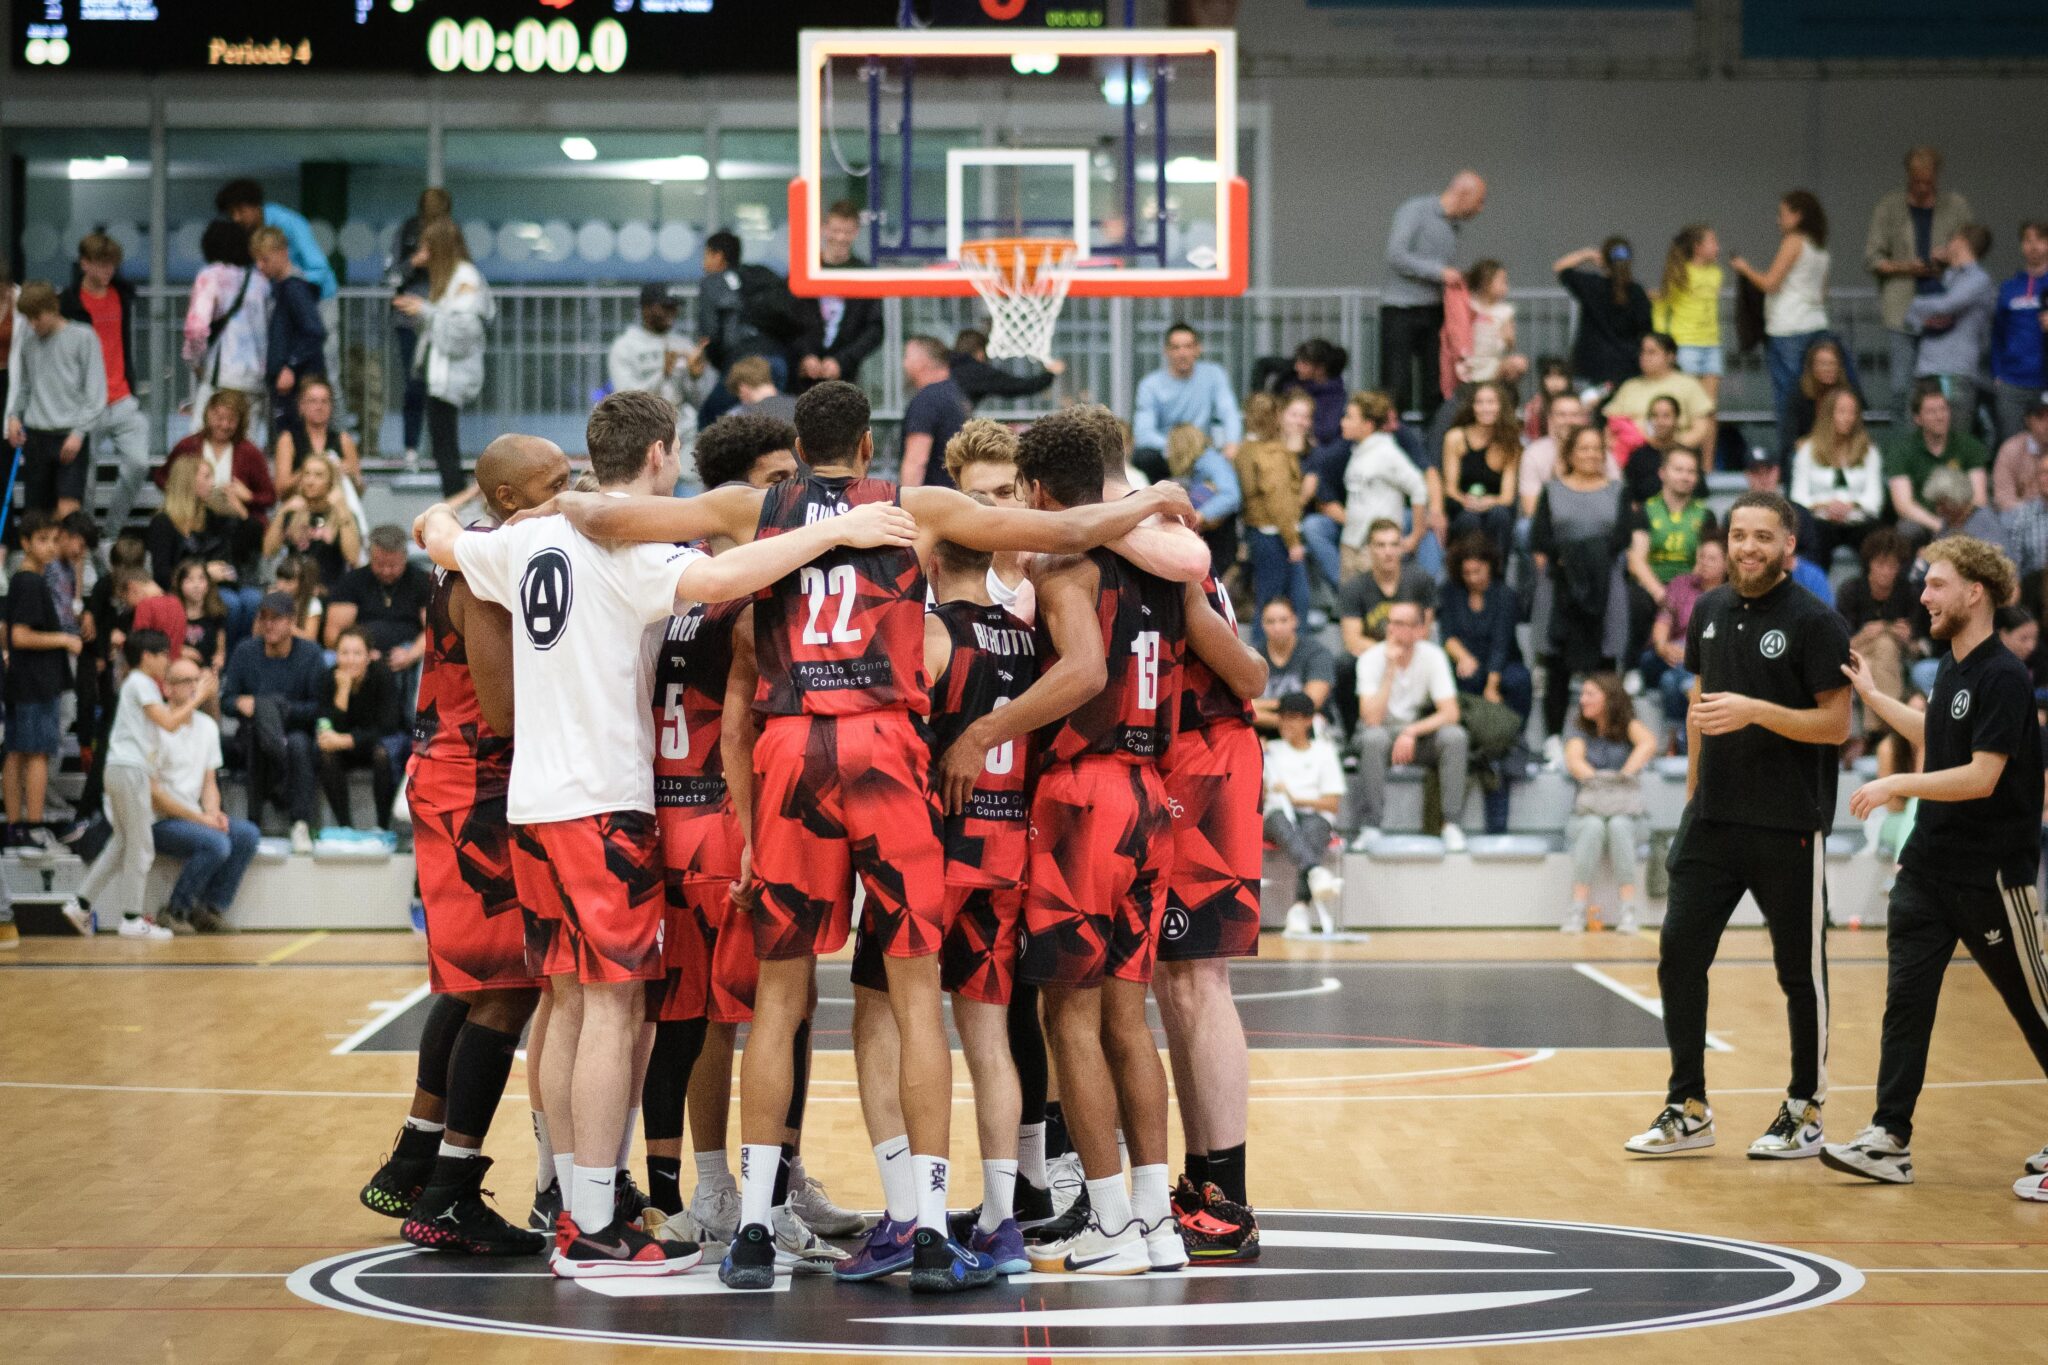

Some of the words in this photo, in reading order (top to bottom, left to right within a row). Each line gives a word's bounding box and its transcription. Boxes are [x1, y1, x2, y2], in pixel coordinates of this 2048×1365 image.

[208, 37, 293, 65] Periode
[295, 37, 312, 65] 4
[427, 16, 628, 73] 00:00.0
[801, 564, 861, 646] 22
[801, 664, 845, 677] Apollo
[812, 675, 872, 688] Connects
[1130, 631, 1160, 710] 13
[660, 683, 690, 760] 5
[930, 1161, 946, 1192] PEAK
